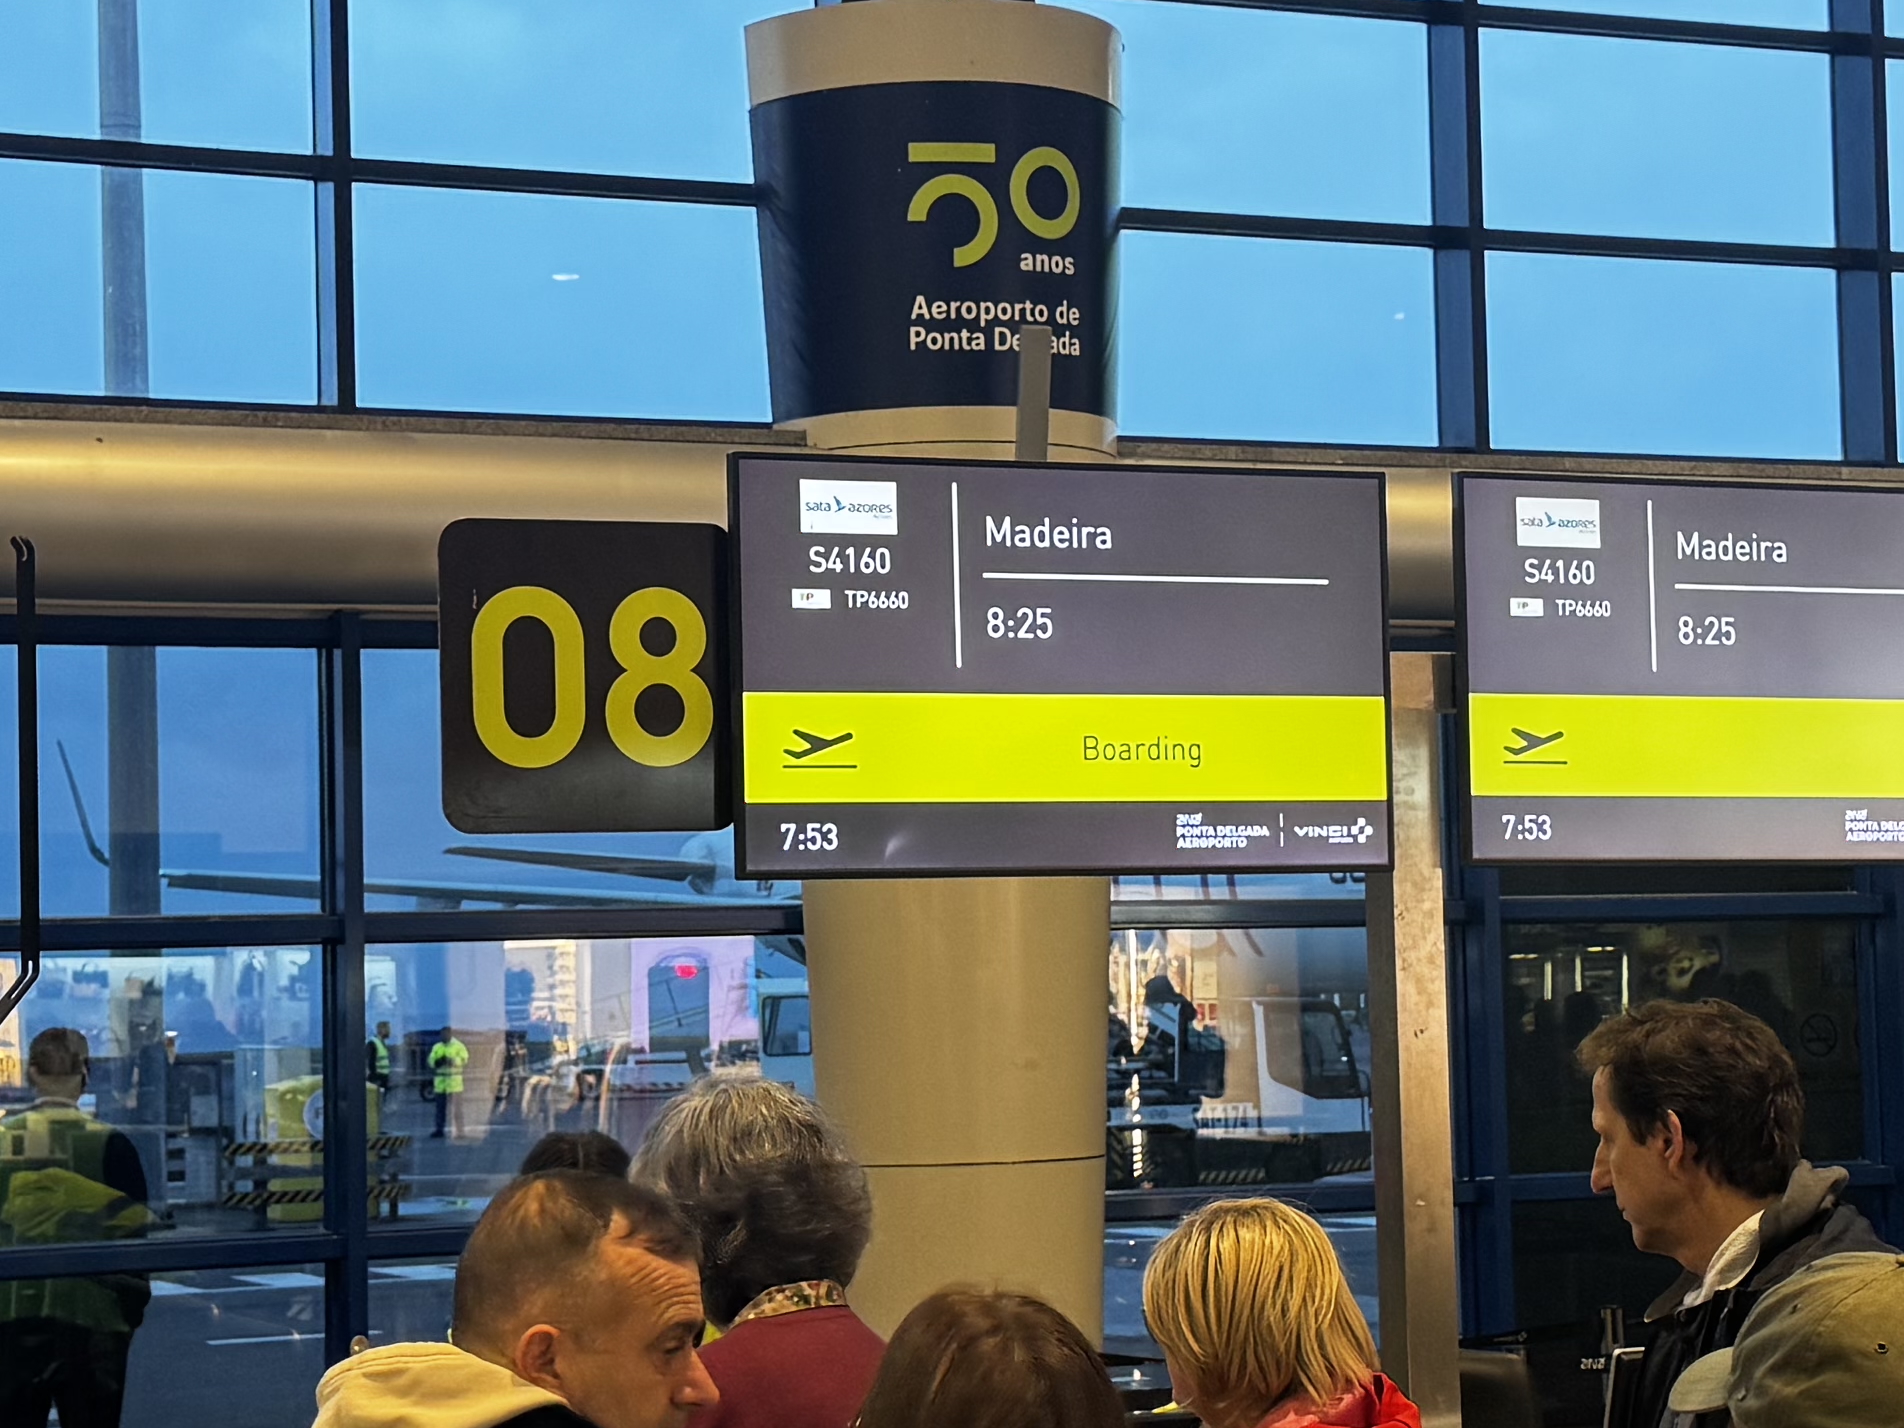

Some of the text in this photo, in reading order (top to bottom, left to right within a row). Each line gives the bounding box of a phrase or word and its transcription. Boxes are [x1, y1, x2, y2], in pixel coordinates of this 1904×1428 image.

[1019, 252, 1075, 275] anos
[910, 294, 1080, 327] Aeroporto de
[909, 326, 1080, 356] Ponta Deada
[805, 500, 831, 512] sata
[985, 515, 1112, 550] Madeira
[808, 546, 892, 574] S4160
[1676, 530, 1788, 563] Madeira
[1524, 558, 1595, 585] S4160
[844, 589, 909, 610] TP6660
[1555, 598, 1611, 618] TP6660
[986, 606, 1054, 640] 8:25
[1678, 615, 1737, 646] 8:25
[471, 584, 714, 768] 08
[1083, 735, 1203, 768] Boarding
[780, 822, 839, 851] 7:53
[1176, 825, 1270, 837] PONTA DELGADA
[1293, 825, 1348, 838] VINCI
[1501, 814, 1552, 841] 7:53
[1845, 820, 1880, 832] PONTA
[1176, 837, 1248, 849] AEROPORTO
